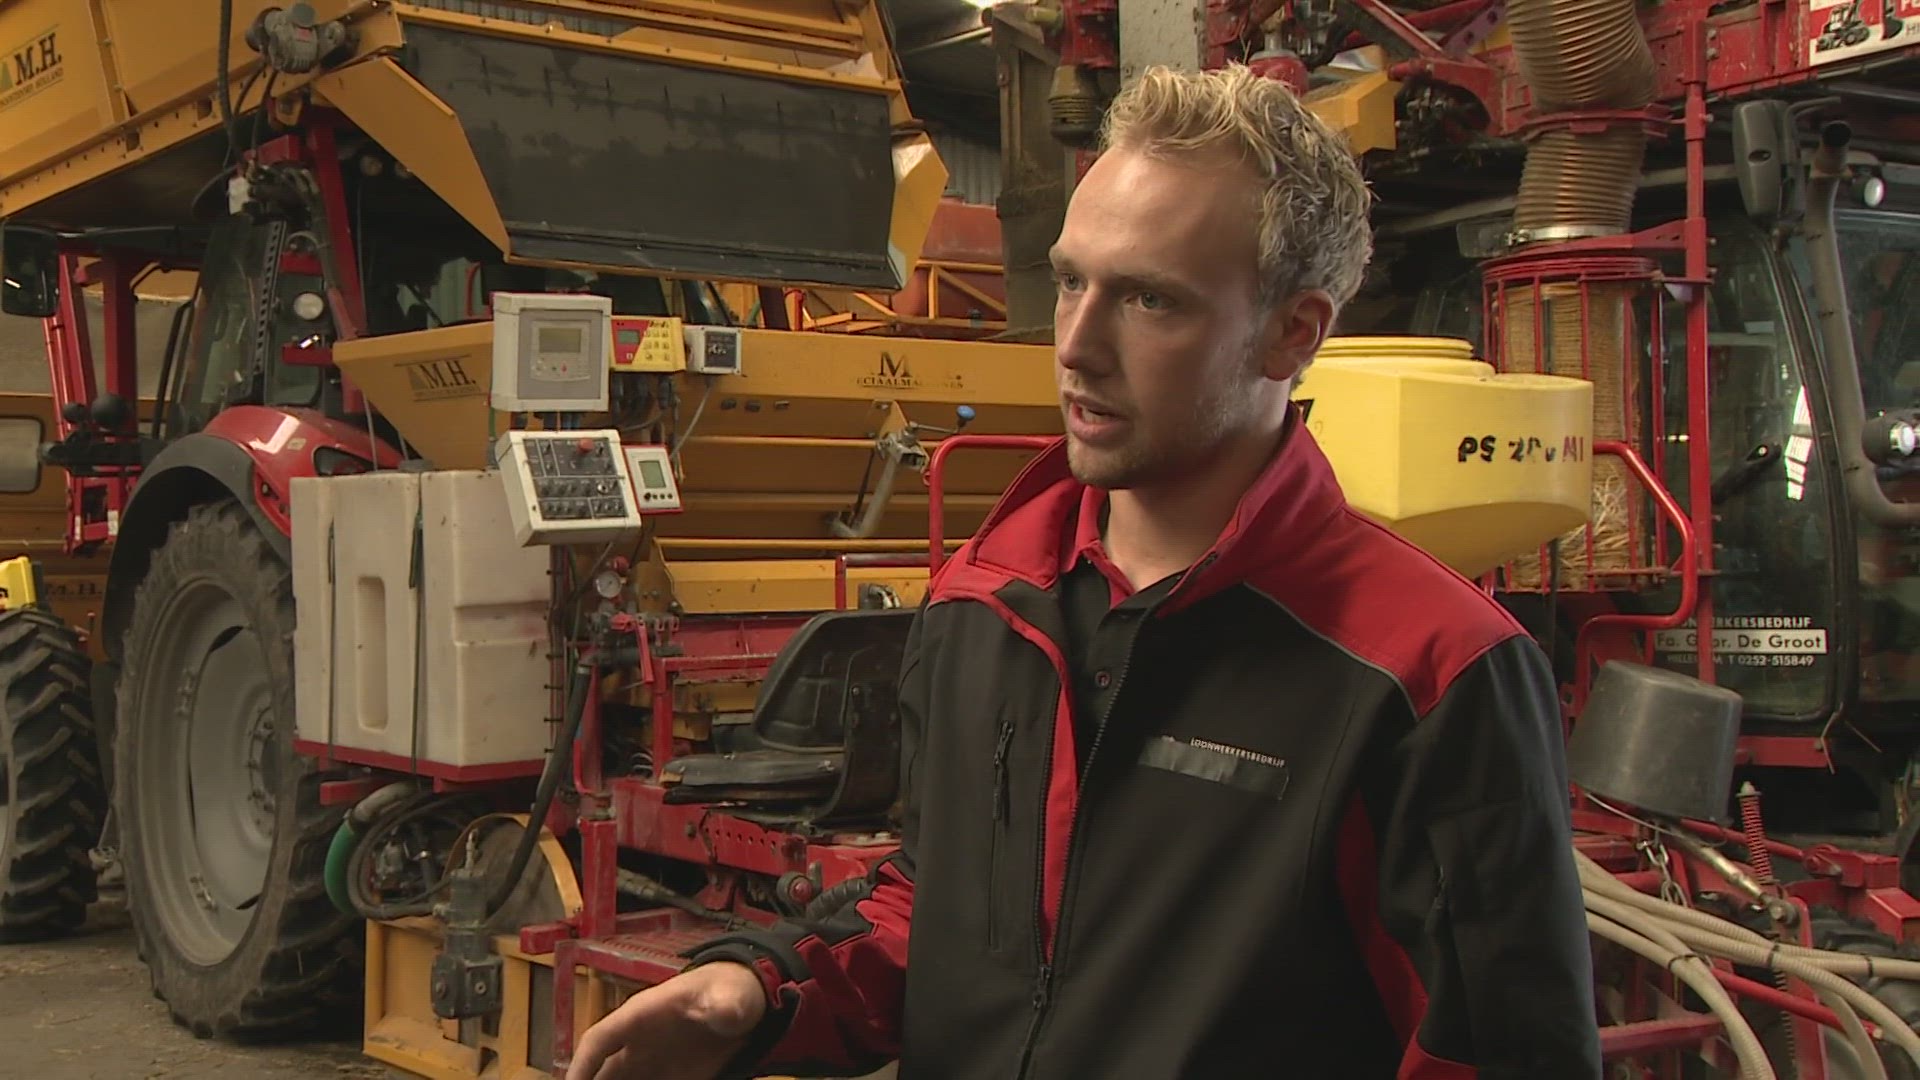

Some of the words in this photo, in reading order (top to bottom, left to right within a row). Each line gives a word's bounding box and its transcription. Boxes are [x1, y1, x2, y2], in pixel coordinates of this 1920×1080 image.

[14, 32, 62, 86] M.H.
[420, 359, 476, 389] M.H.
[1458, 435, 1496, 462] PS
[1738, 634, 1762, 648] De
[1769, 634, 1821, 649] Groot
[1738, 655, 1815, 667] 0252-515849
